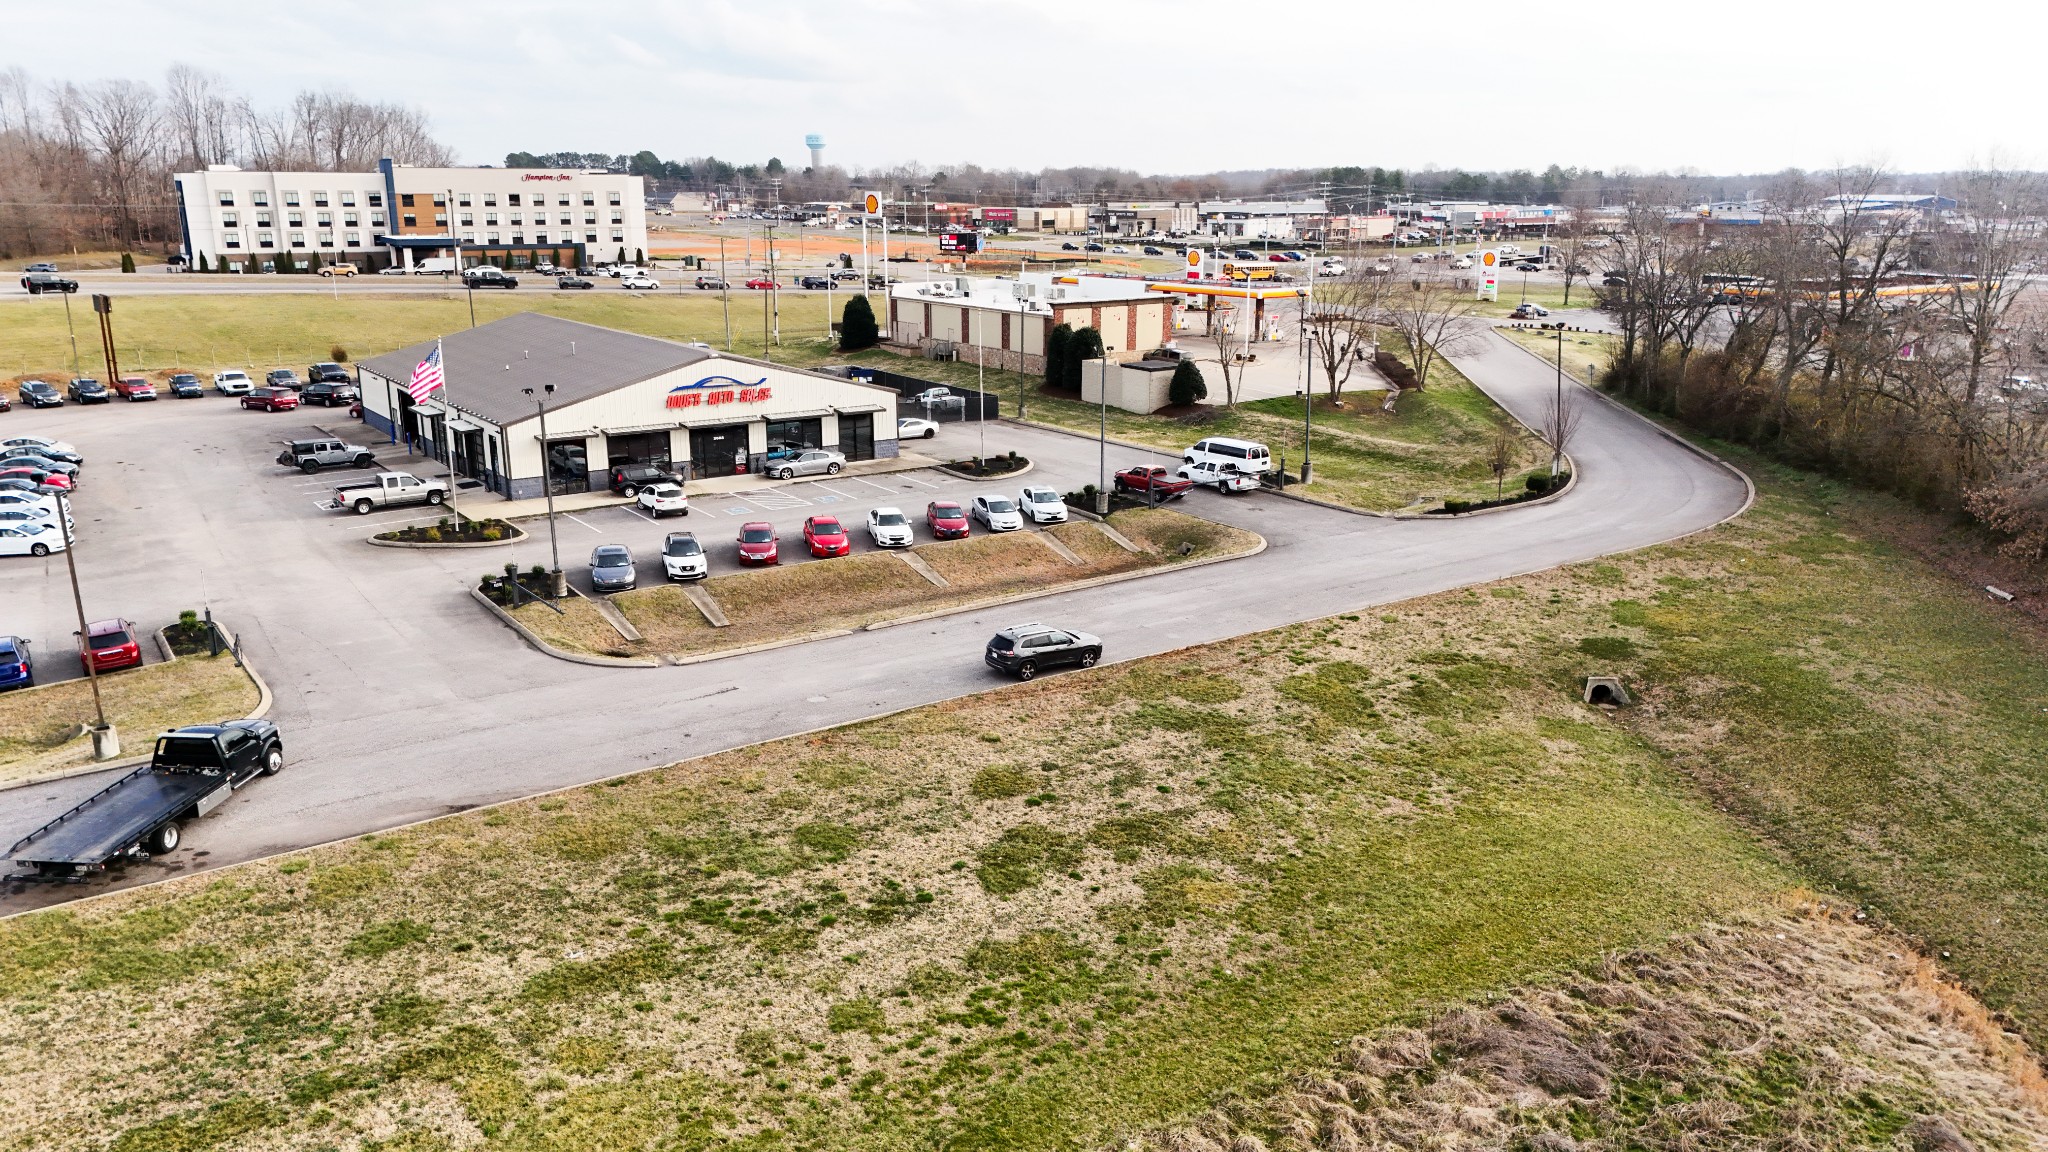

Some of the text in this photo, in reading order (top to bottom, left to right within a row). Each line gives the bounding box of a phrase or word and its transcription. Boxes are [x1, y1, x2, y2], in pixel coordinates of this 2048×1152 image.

[521, 173, 572, 181] Hampton Inn
[666, 388, 771, 408] DOUG'S AUTO SALES
